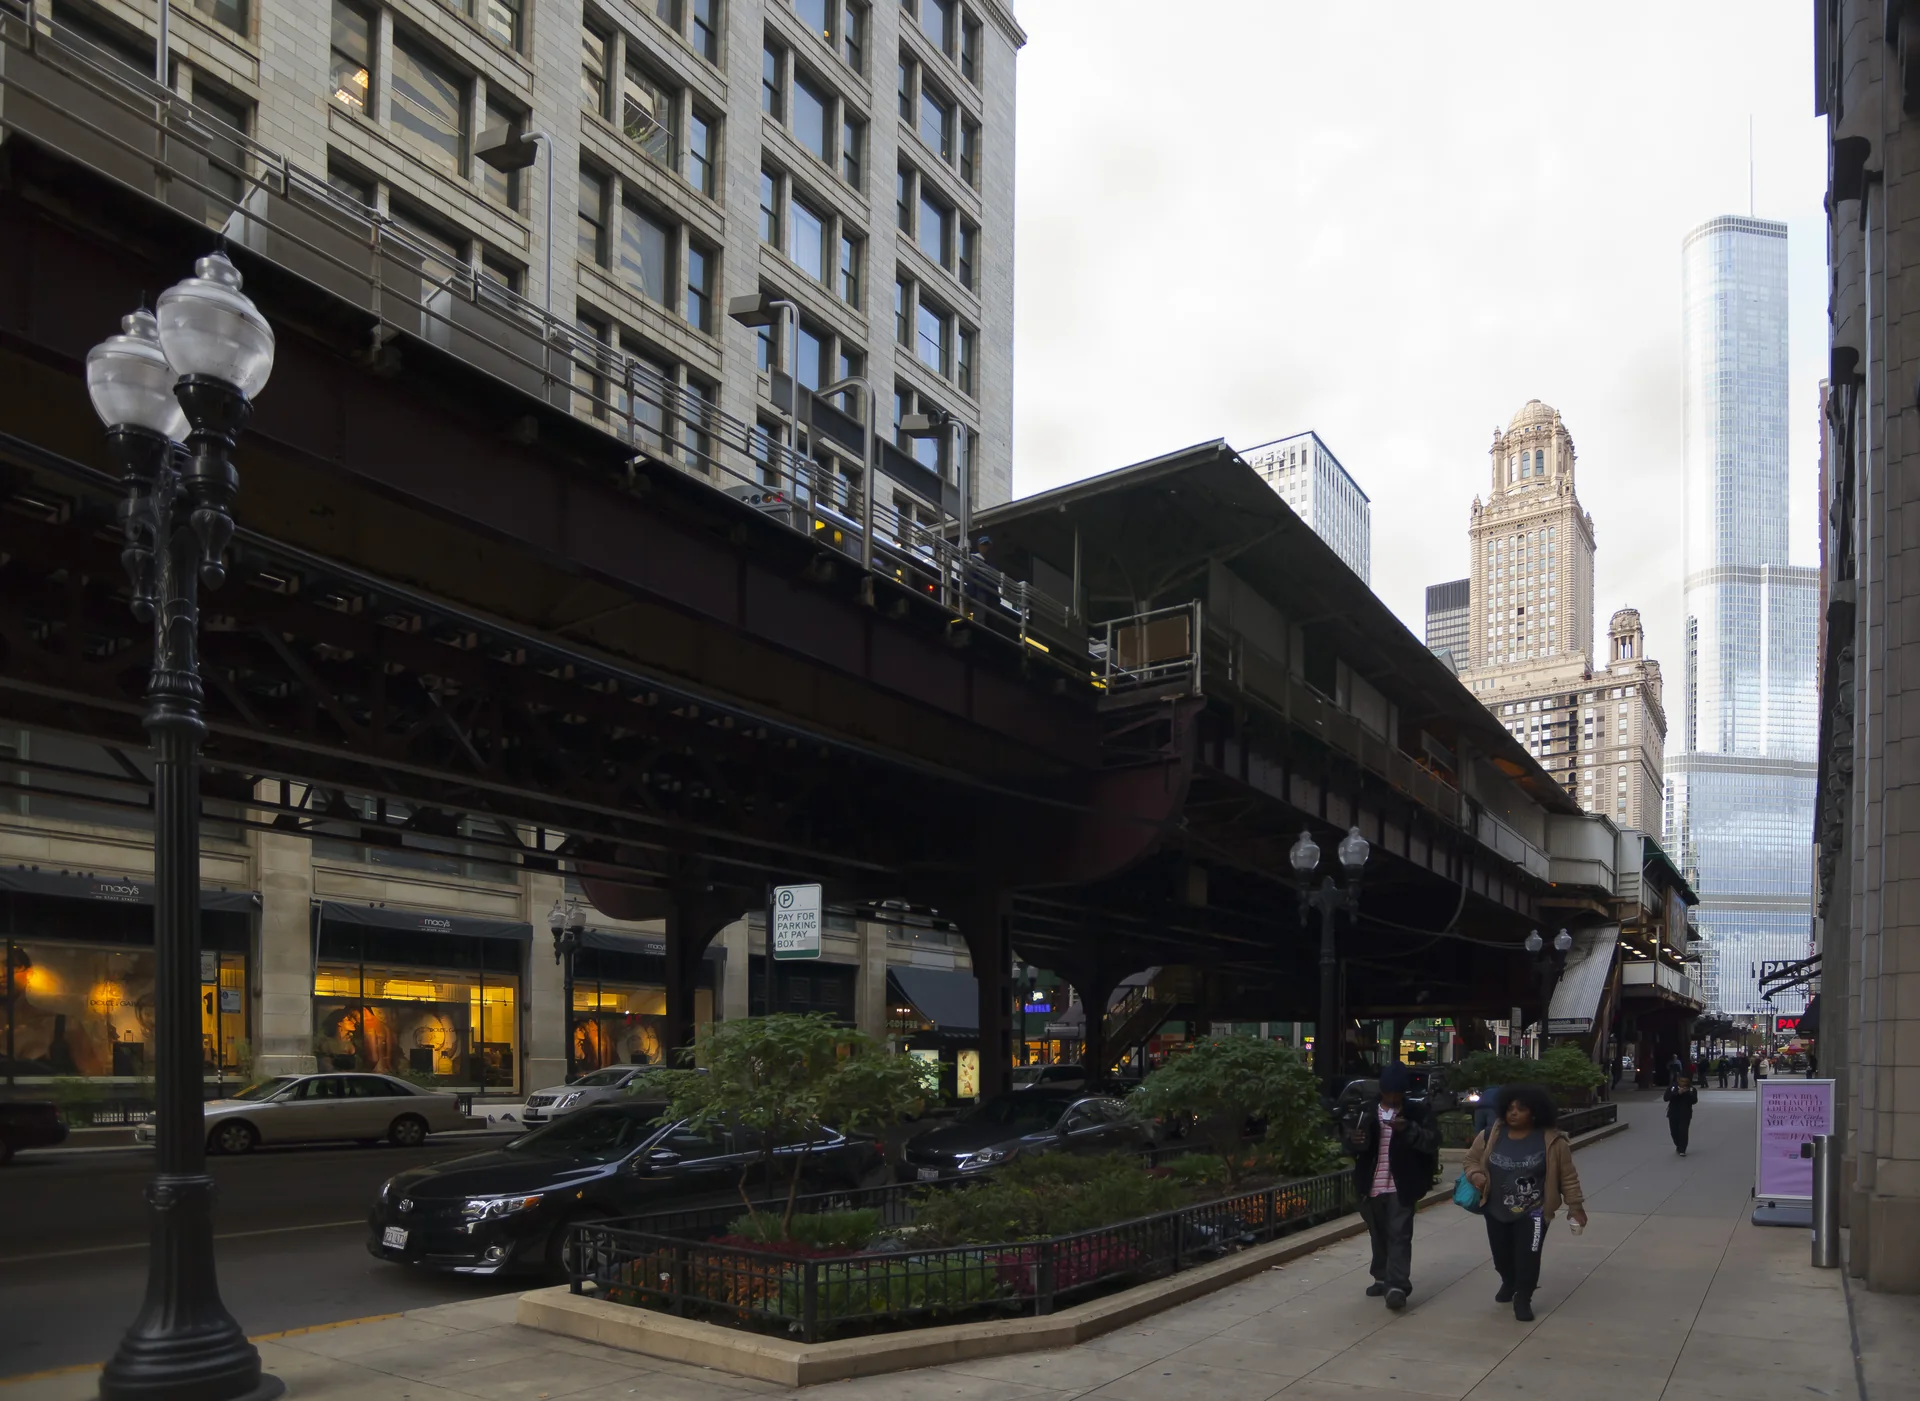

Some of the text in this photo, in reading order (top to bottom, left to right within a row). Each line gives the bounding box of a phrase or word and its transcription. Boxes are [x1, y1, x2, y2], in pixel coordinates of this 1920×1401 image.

[101, 884, 139, 895] macy's
[778, 913, 814, 922] PAY FOR
[424, 919, 451, 928] macy's
[777, 921, 816, 931] PARKING
[778, 930, 807, 939] AT PAY
[777, 940, 795, 948] BOX
